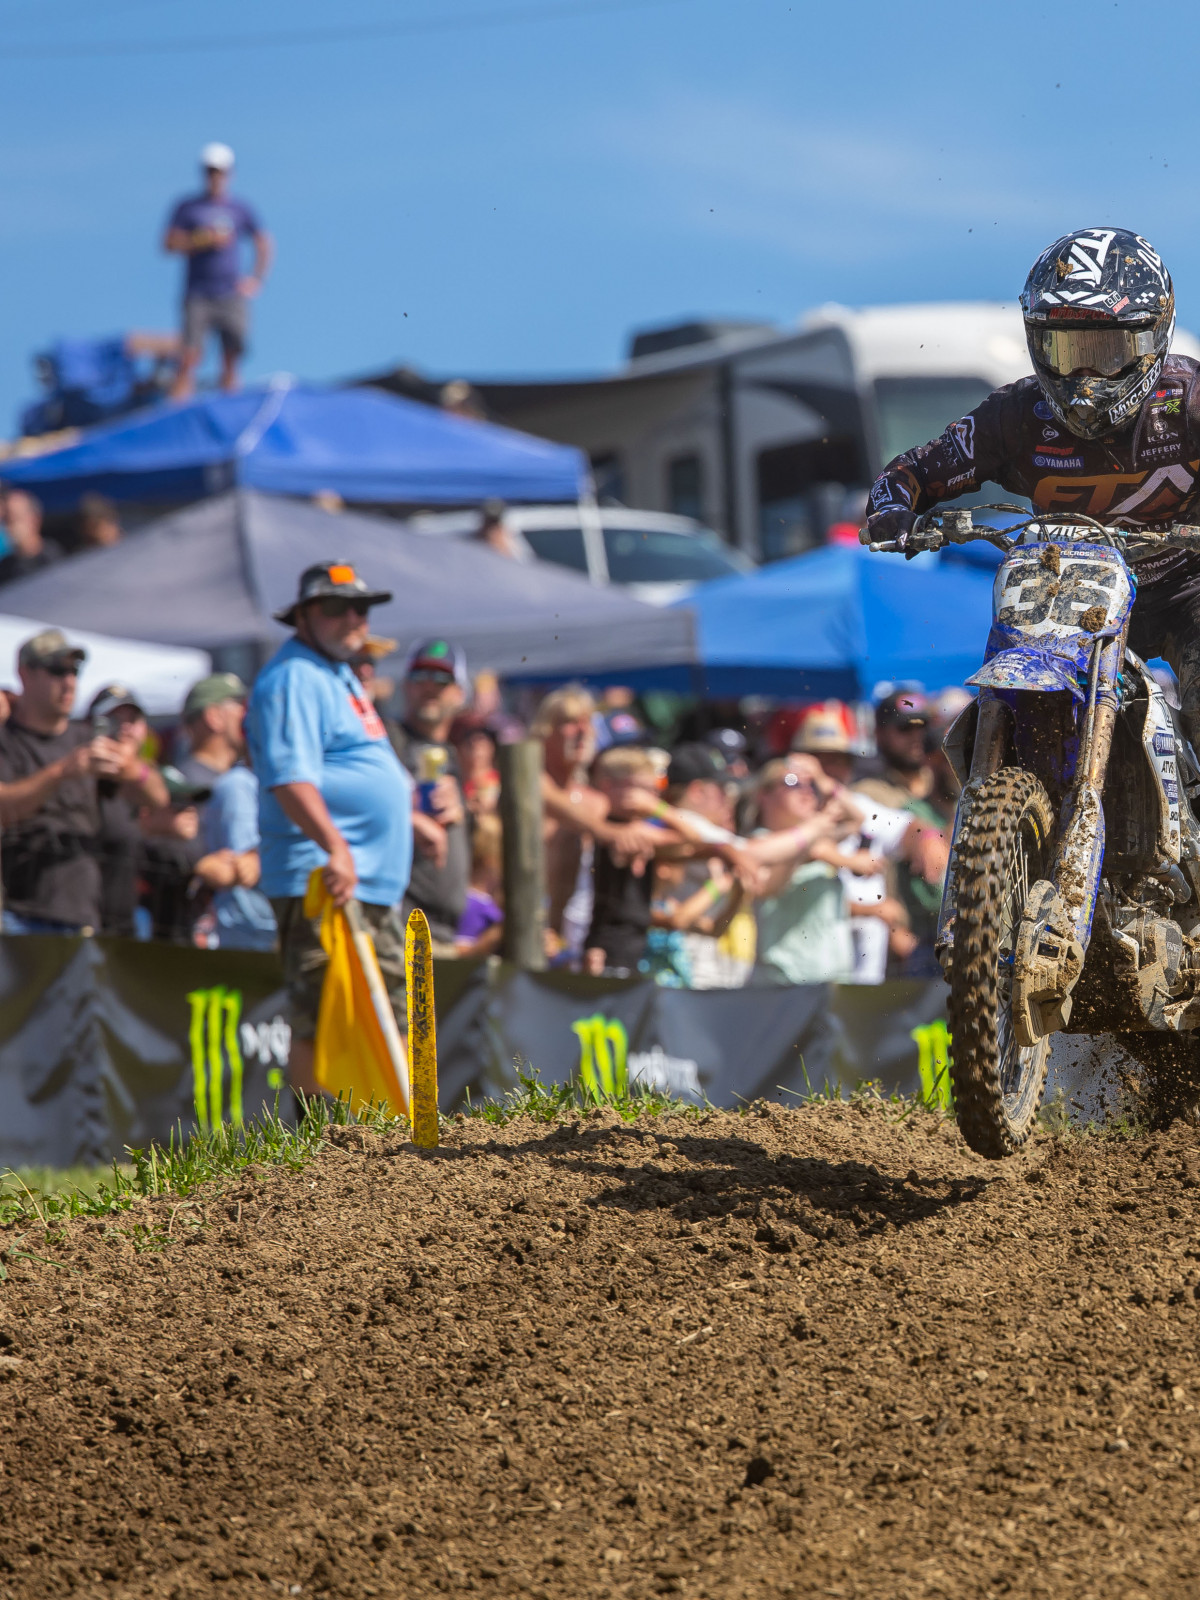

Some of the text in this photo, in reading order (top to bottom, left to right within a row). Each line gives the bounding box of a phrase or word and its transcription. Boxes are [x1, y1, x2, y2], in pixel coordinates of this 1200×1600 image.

[1141, 443, 1181, 457] JEFFERY
[1045, 457, 1082, 468] YAMAHA
[999, 563, 1117, 628] 36
